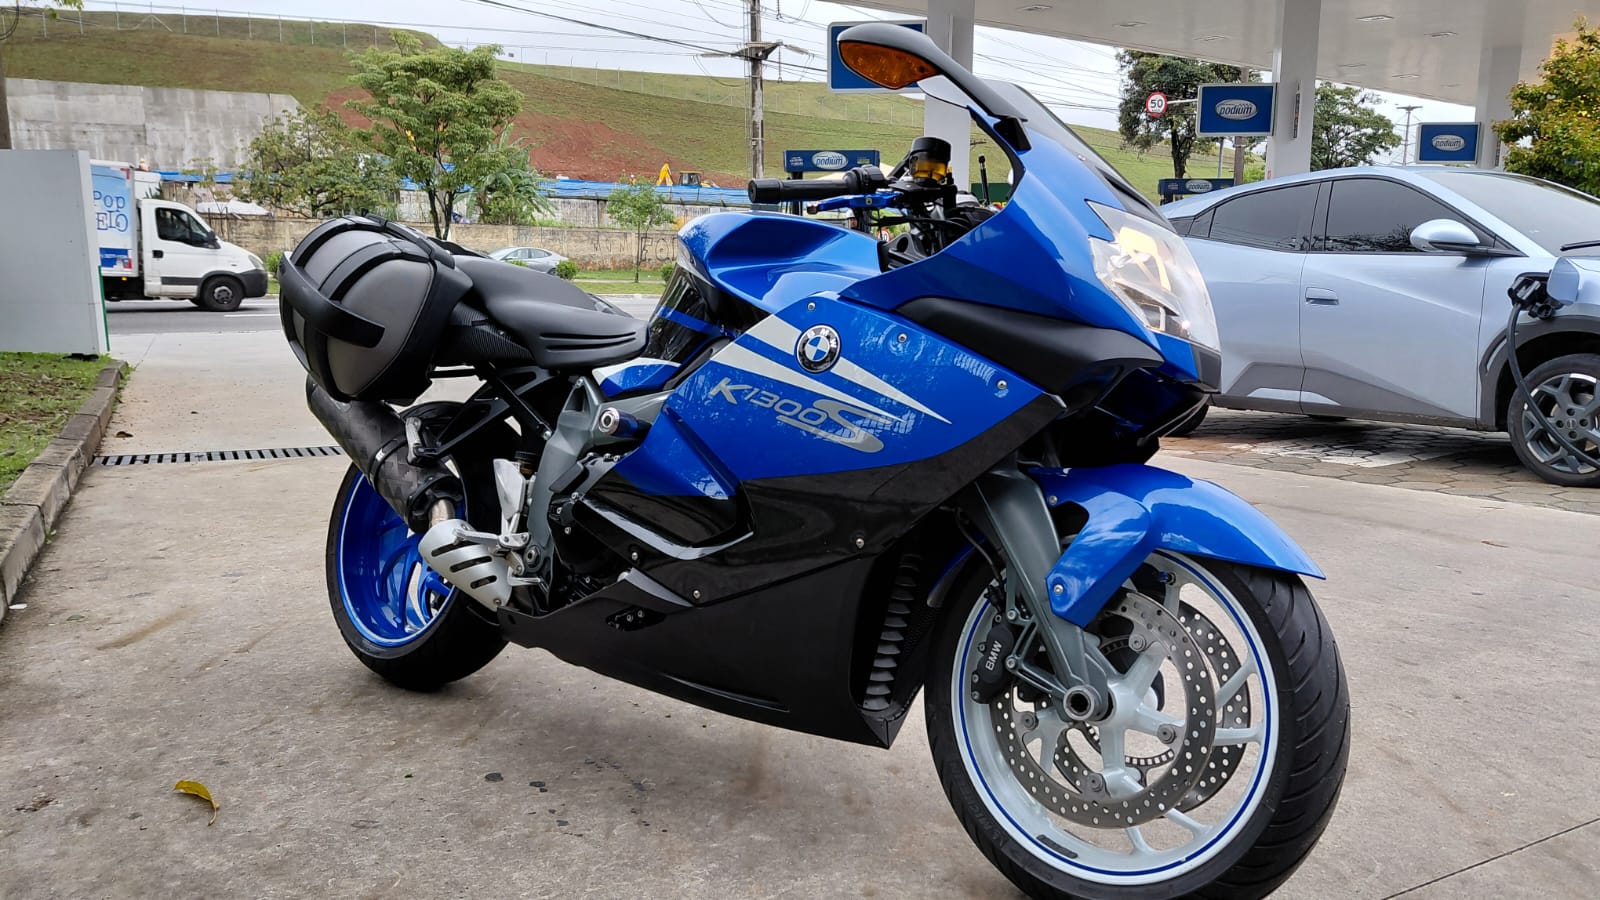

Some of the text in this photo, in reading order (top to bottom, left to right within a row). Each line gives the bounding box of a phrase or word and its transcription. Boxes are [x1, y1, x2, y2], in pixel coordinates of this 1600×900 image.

[1150, 98, 1164, 109] 50
[1219, 104, 1252, 115] podium
[815, 156, 843, 167] podium
[807, 328, 838, 348] BMW
[985, 640, 1003, 671] BMW
